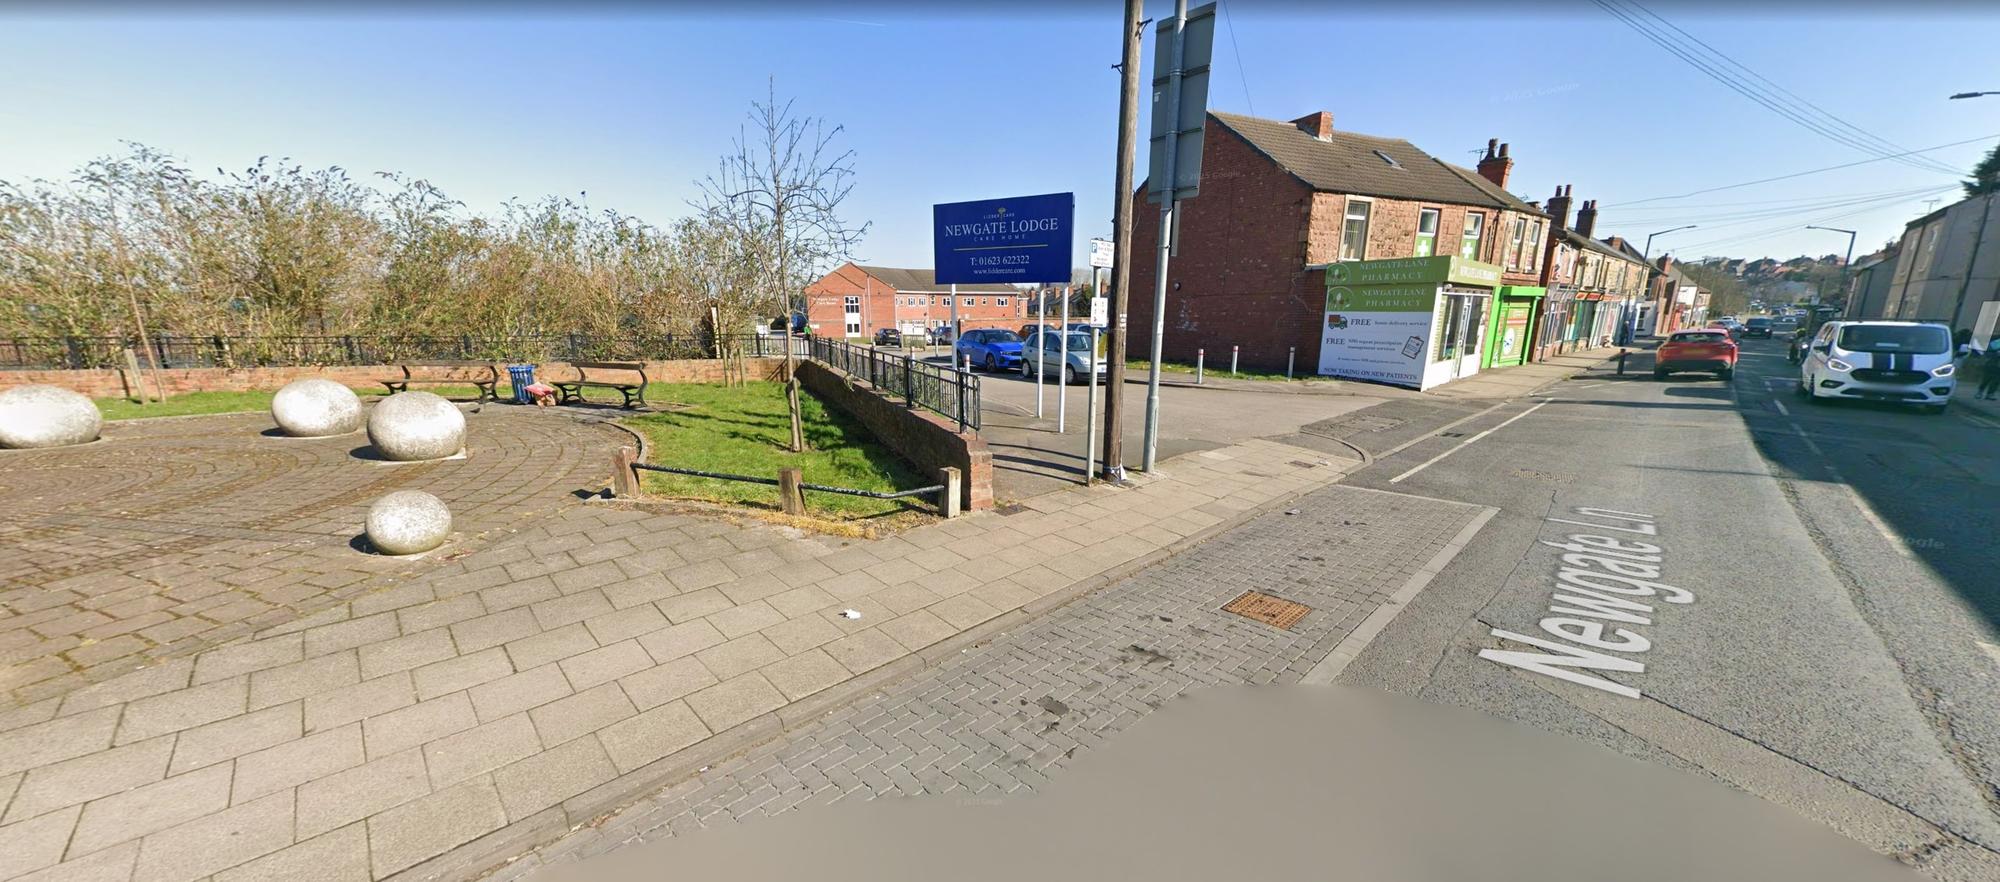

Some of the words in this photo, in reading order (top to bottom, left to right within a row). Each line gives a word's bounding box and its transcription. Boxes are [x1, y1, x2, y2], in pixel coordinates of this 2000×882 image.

[944, 221, 1007, 237] NEWGATE
[1011, 218, 1059, 233] LODGE
[970, 257, 978, 266] T:
[979, 256, 1000, 265] 01623
[1002, 255, 1030, 265] 622322
[1360, 261, 1401, 270] NEWGATE
[1402, 259, 1430, 268] LANE
[1362, 271, 1424, 281] PHARMACY
[1362, 288, 1403, 297] NEWGATE
[1404, 287, 1425, 296] LANE
[1366, 299, 1421, 307] PHARMACY
[1350, 318, 1371, 326] FREE
[1326, 337, 1345, 345] FREE
[1386, 372, 1417, 380] PATIENTS
